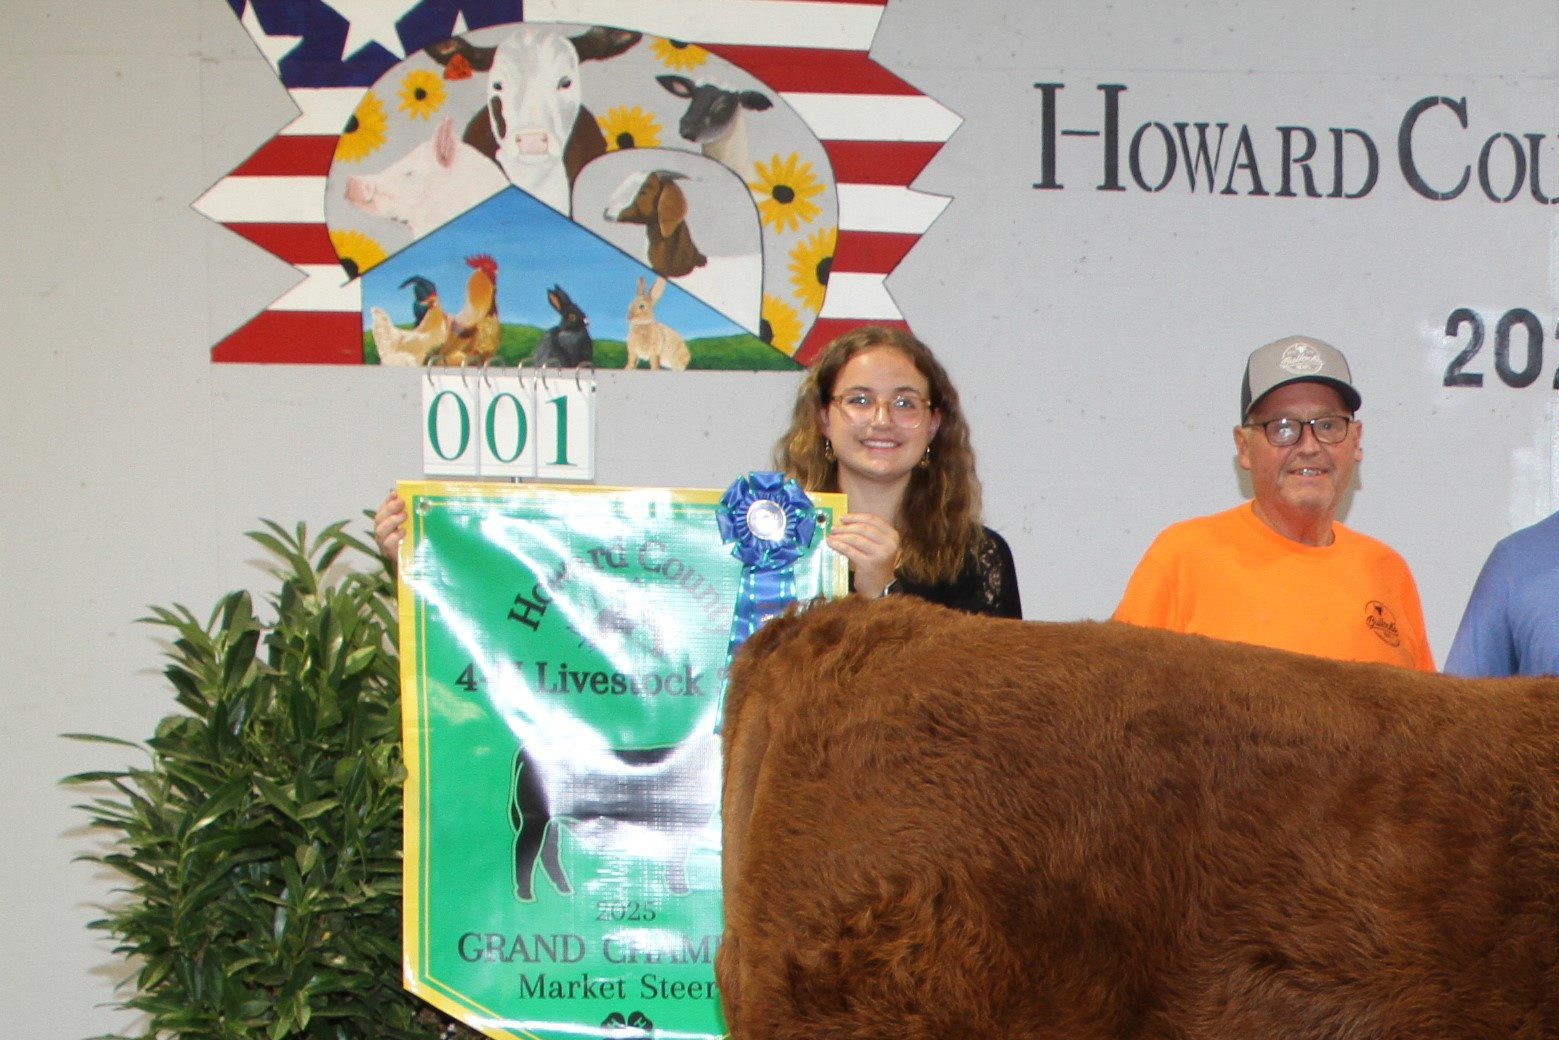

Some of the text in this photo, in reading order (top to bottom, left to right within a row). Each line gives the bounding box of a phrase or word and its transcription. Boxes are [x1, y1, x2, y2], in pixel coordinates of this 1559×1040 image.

[427, 390, 577, 467] 001
[507, 536, 629, 632] Hord
[535, 661, 705, 697] Livestock
[595, 901, 656, 922] 2025
[457, 931, 587, 964] GRAND
[519, 973, 717, 1000] Market Steer
